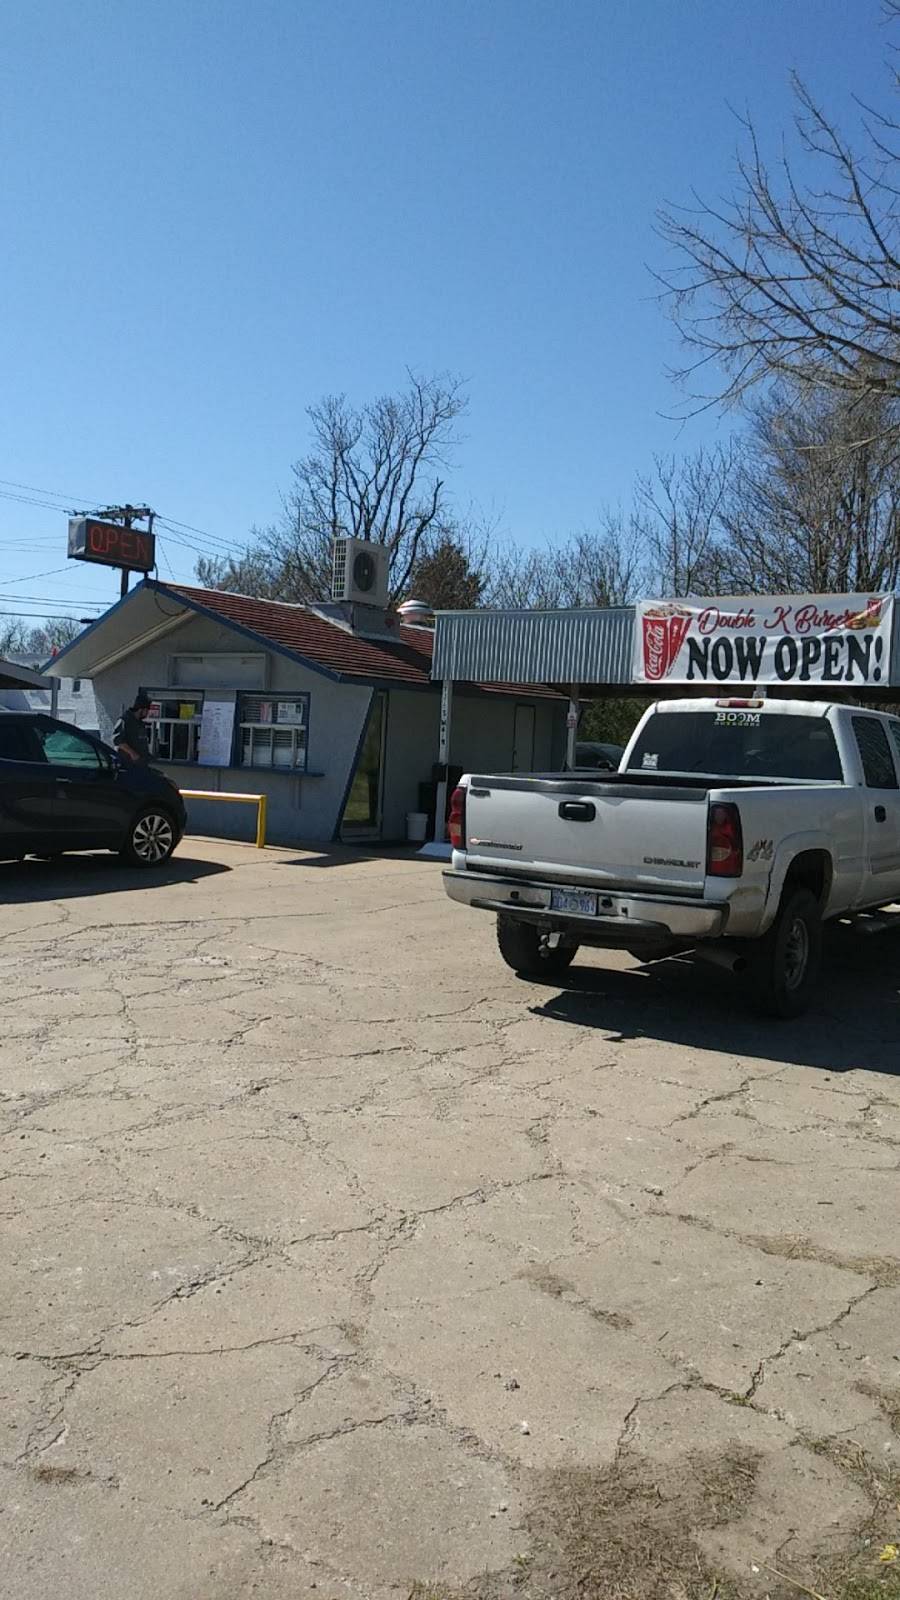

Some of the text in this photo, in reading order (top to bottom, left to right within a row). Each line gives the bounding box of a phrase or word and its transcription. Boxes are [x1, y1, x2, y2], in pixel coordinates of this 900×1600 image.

[90, 526, 146, 561] OPEN
[697, 606, 757, 635] Double
[763, 605, 792, 635] K
[686, 634, 883, 682] NOW OPEN!
[643, 856, 702, 869] CHEVROLET
